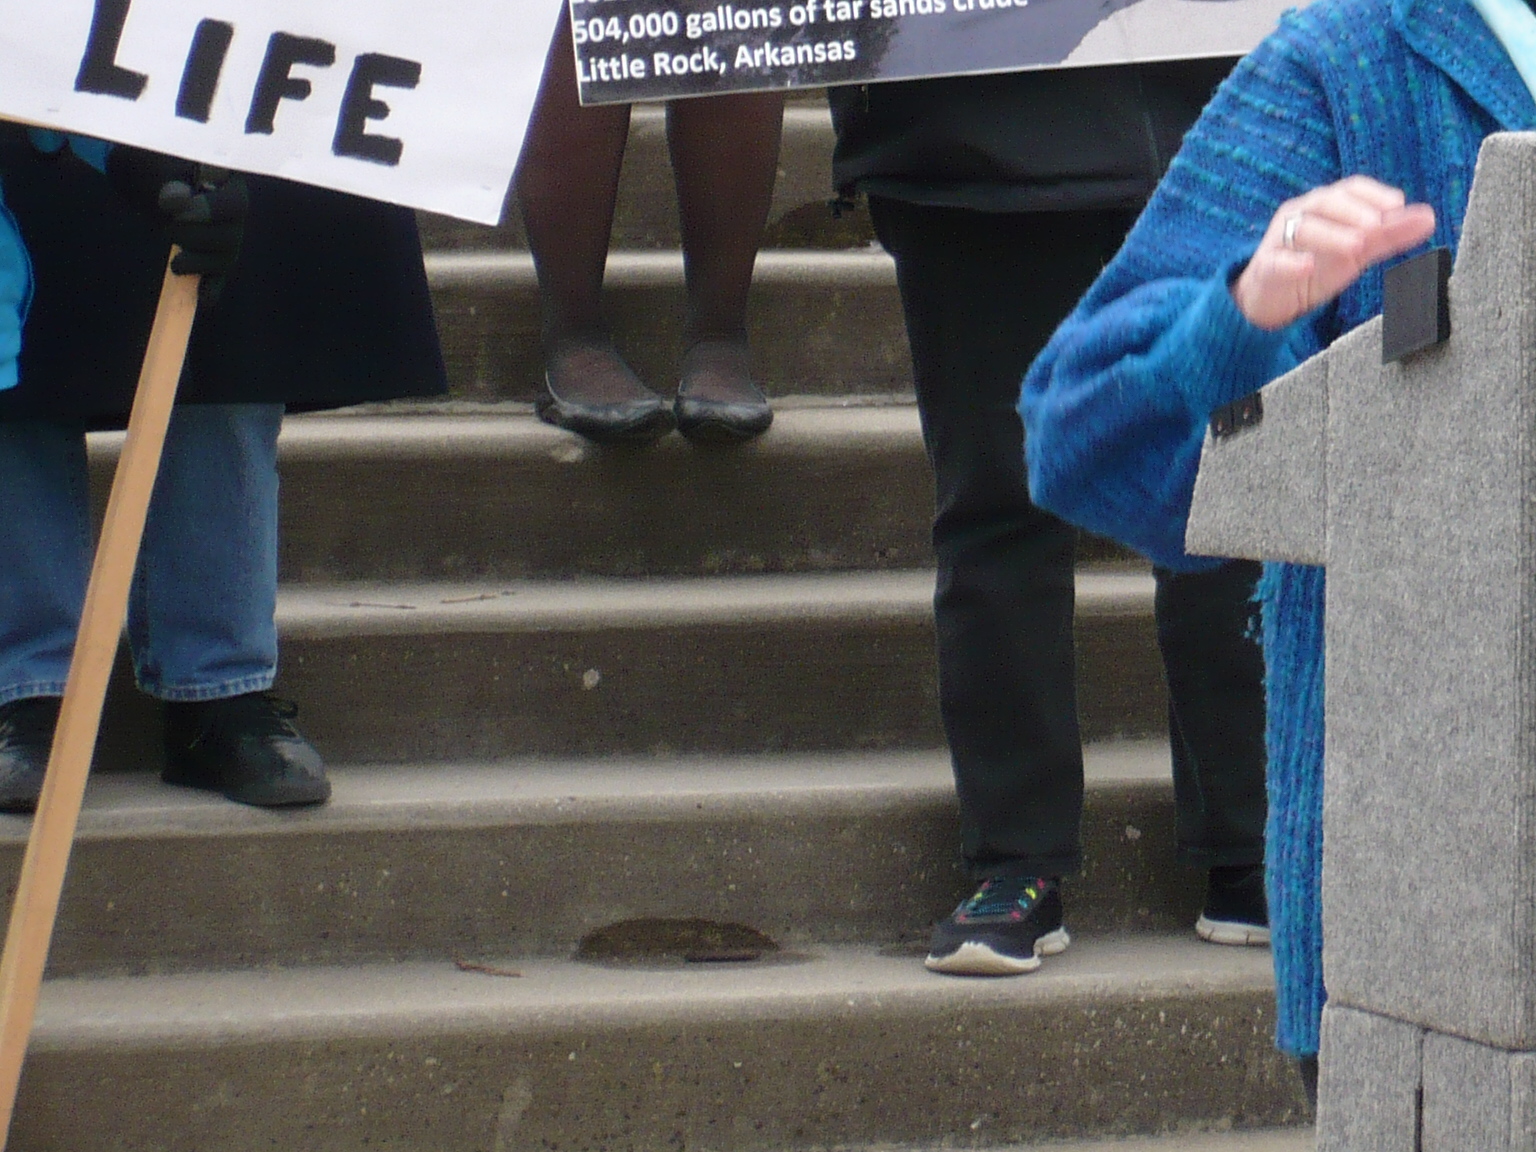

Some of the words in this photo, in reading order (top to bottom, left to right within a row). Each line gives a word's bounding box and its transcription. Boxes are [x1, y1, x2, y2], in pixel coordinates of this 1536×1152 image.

[573, 10, 679, 45] 504,000
[686, 1, 782, 40] gallons
[788, 0, 817, 27] of
[576, 53, 646, 83] Little
[653, 44, 727, 75] Rock,
[734, 37, 857, 70] Arkansas
